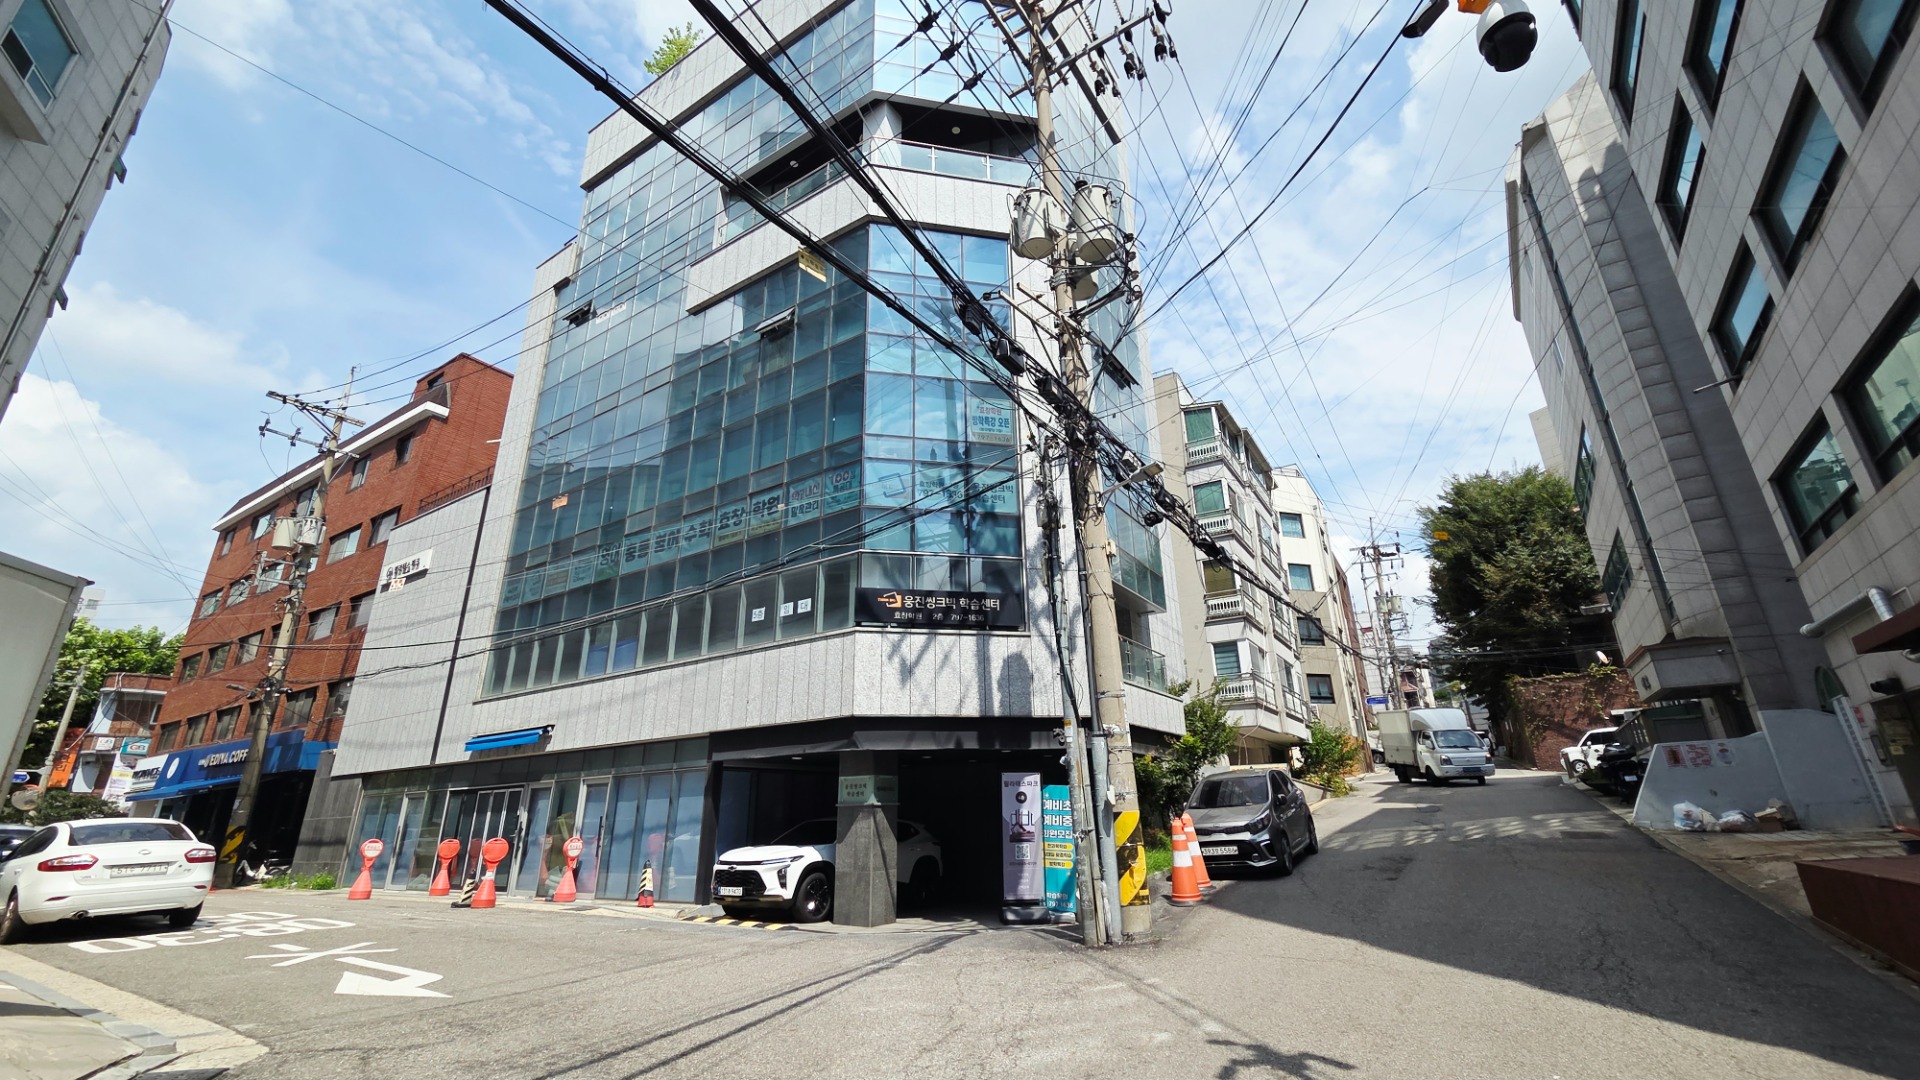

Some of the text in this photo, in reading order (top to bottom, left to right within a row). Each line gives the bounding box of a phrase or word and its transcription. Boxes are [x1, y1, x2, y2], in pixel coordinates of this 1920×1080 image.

[972, 415, 1010, 429] 방학특강 오픈
[683, 519, 712, 544] 수학
[717, 505, 747, 532] 효창
[752, 495, 782, 519] 학원
[903, 595, 957, 610] 웅진씽크빅
[959, 597, 1000, 611] 학습센터
[950, 613, 985, 622] 797-1636
[209, 753, 229, 767] EDIYA
[229, 749, 249, 763] COFF
[1043, 814, 1073, 827] 예비중
